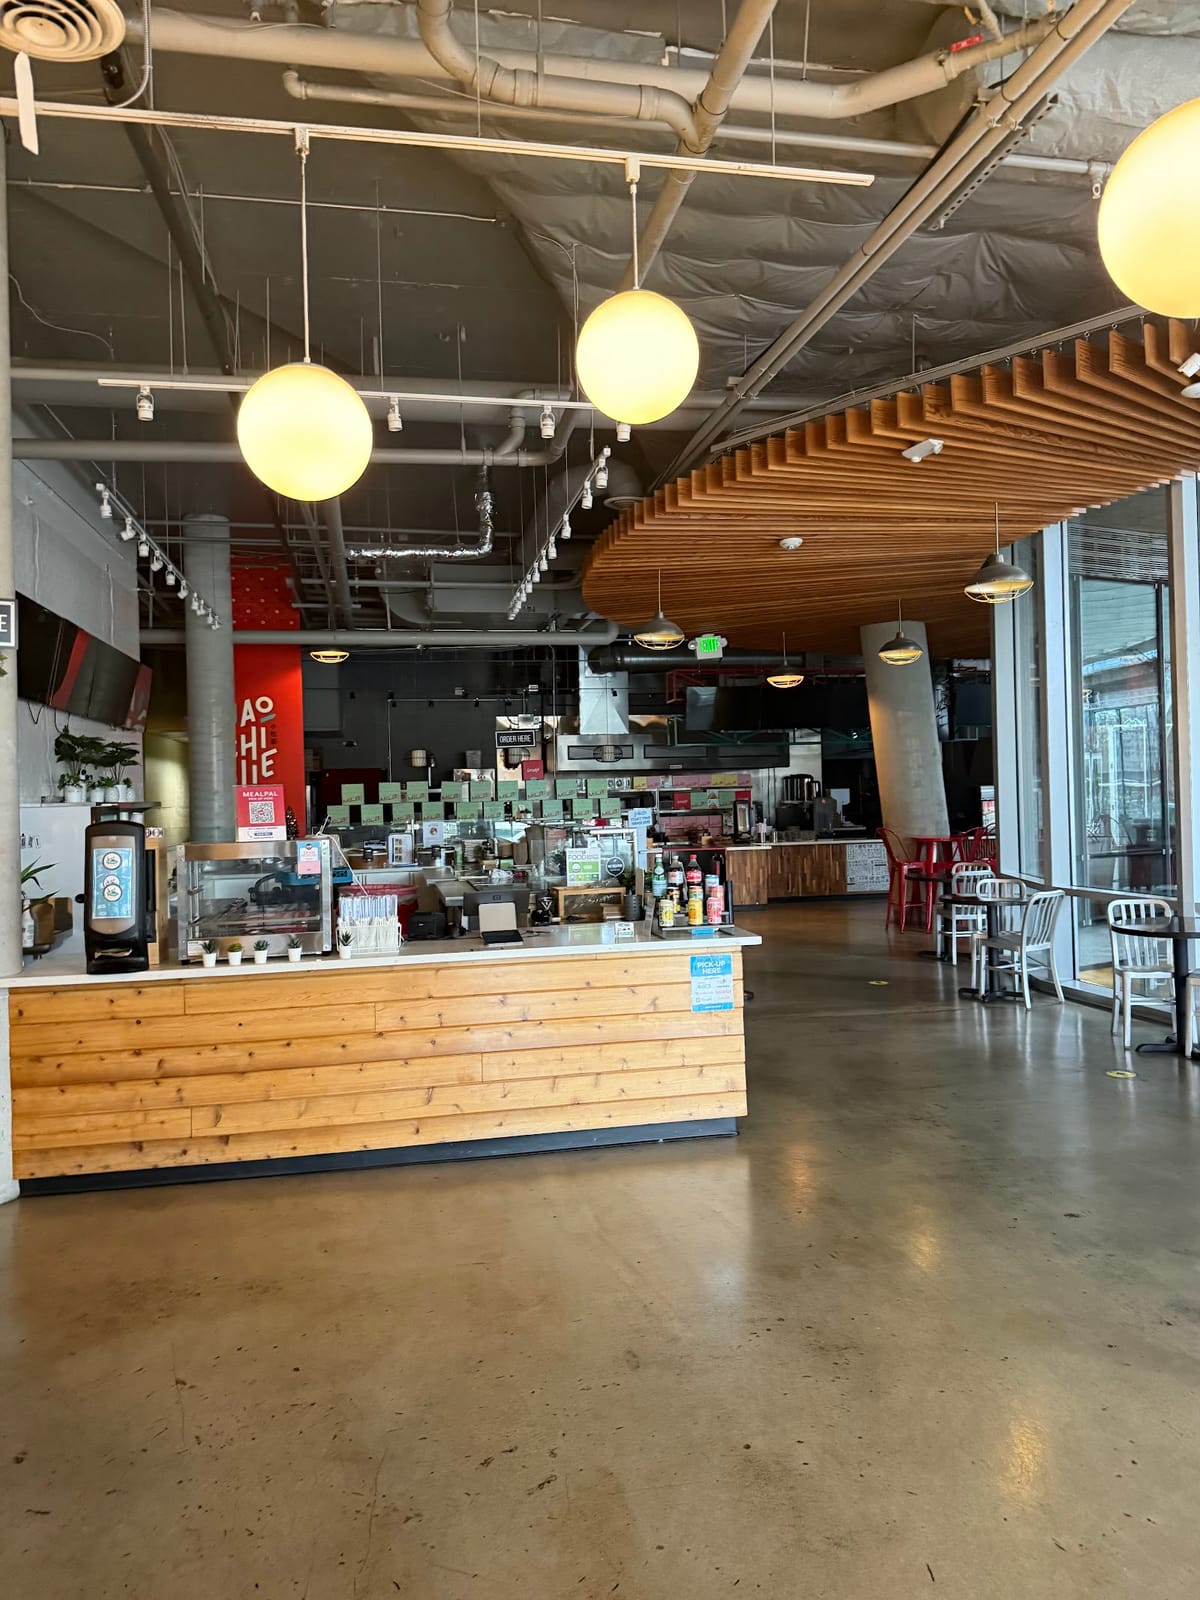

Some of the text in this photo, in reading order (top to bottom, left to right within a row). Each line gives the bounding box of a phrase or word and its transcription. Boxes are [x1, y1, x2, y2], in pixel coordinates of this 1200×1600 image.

[701, 638, 719, 652] EXIT
[235, 726, 266, 760] HI
[500, 734, 531, 743] ORDER HERE
[697, 960, 726, 969] PICK-UP
[702, 967, 721, 975] HERE
